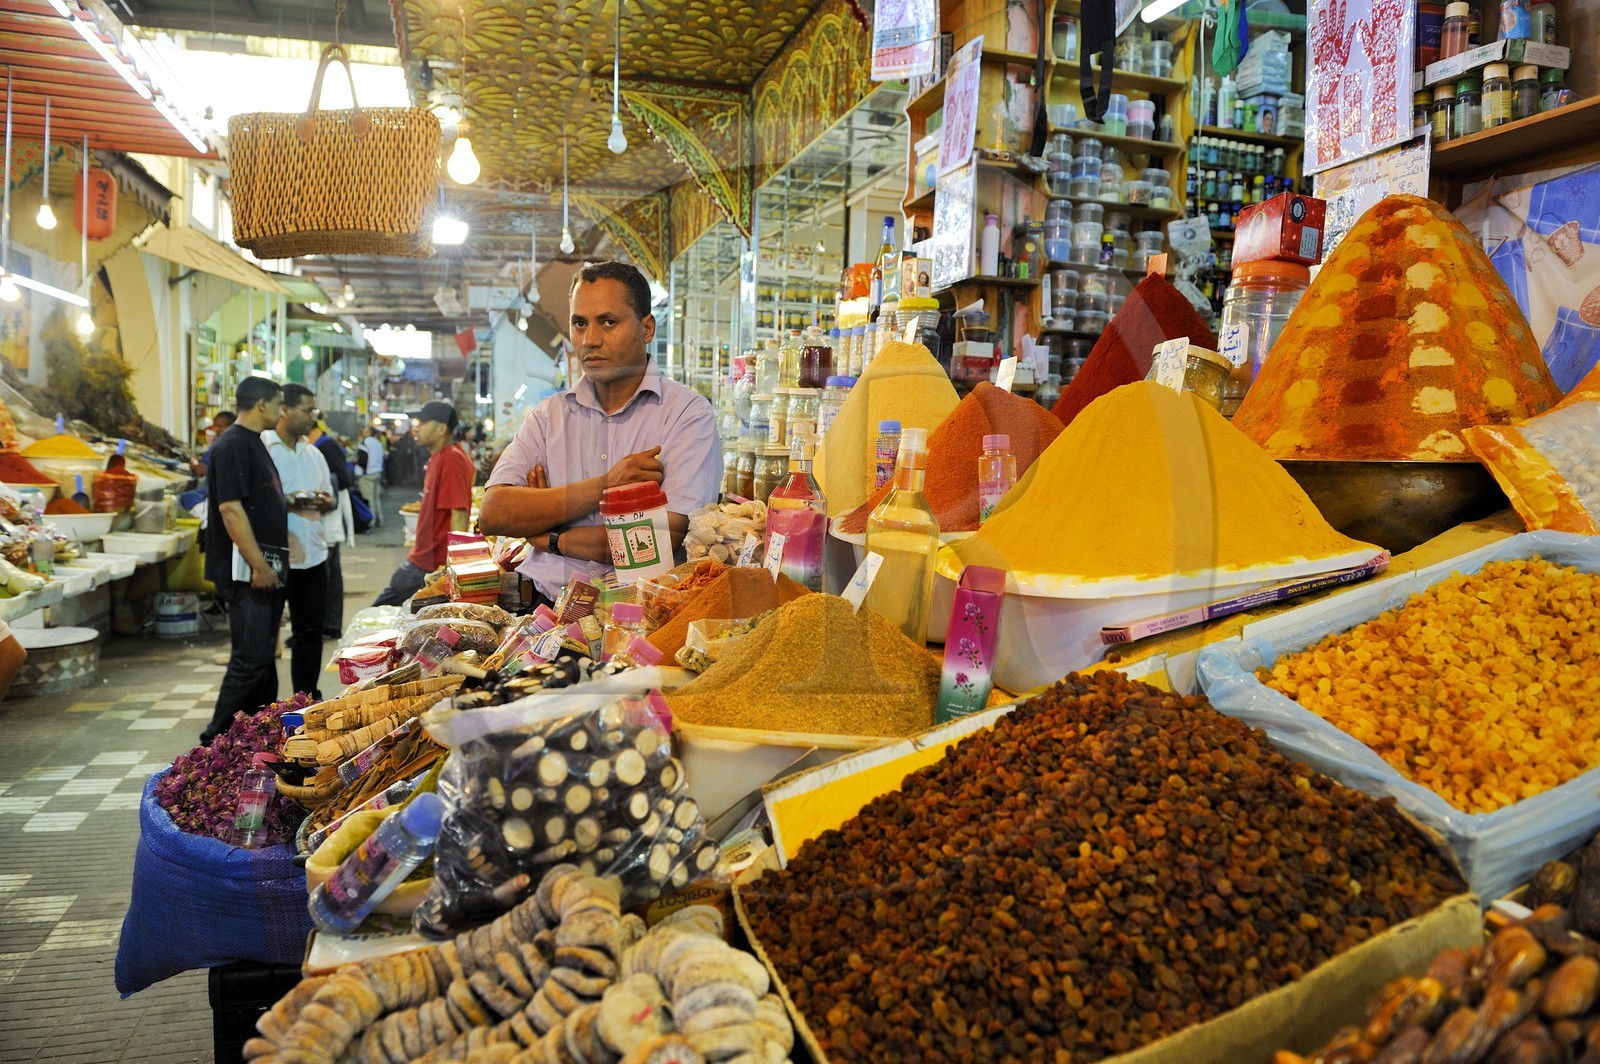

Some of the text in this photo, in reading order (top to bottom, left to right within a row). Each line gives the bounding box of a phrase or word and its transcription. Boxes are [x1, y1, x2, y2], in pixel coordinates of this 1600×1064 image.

[633, 512, 644, 520] DH
[1338, 570, 1366, 583] QUEEN
[1160, 616, 1179, 625] EXPORT
[1104, 631, 1127, 642] QUEEN
[658, 887, 719, 908] APRICOT
